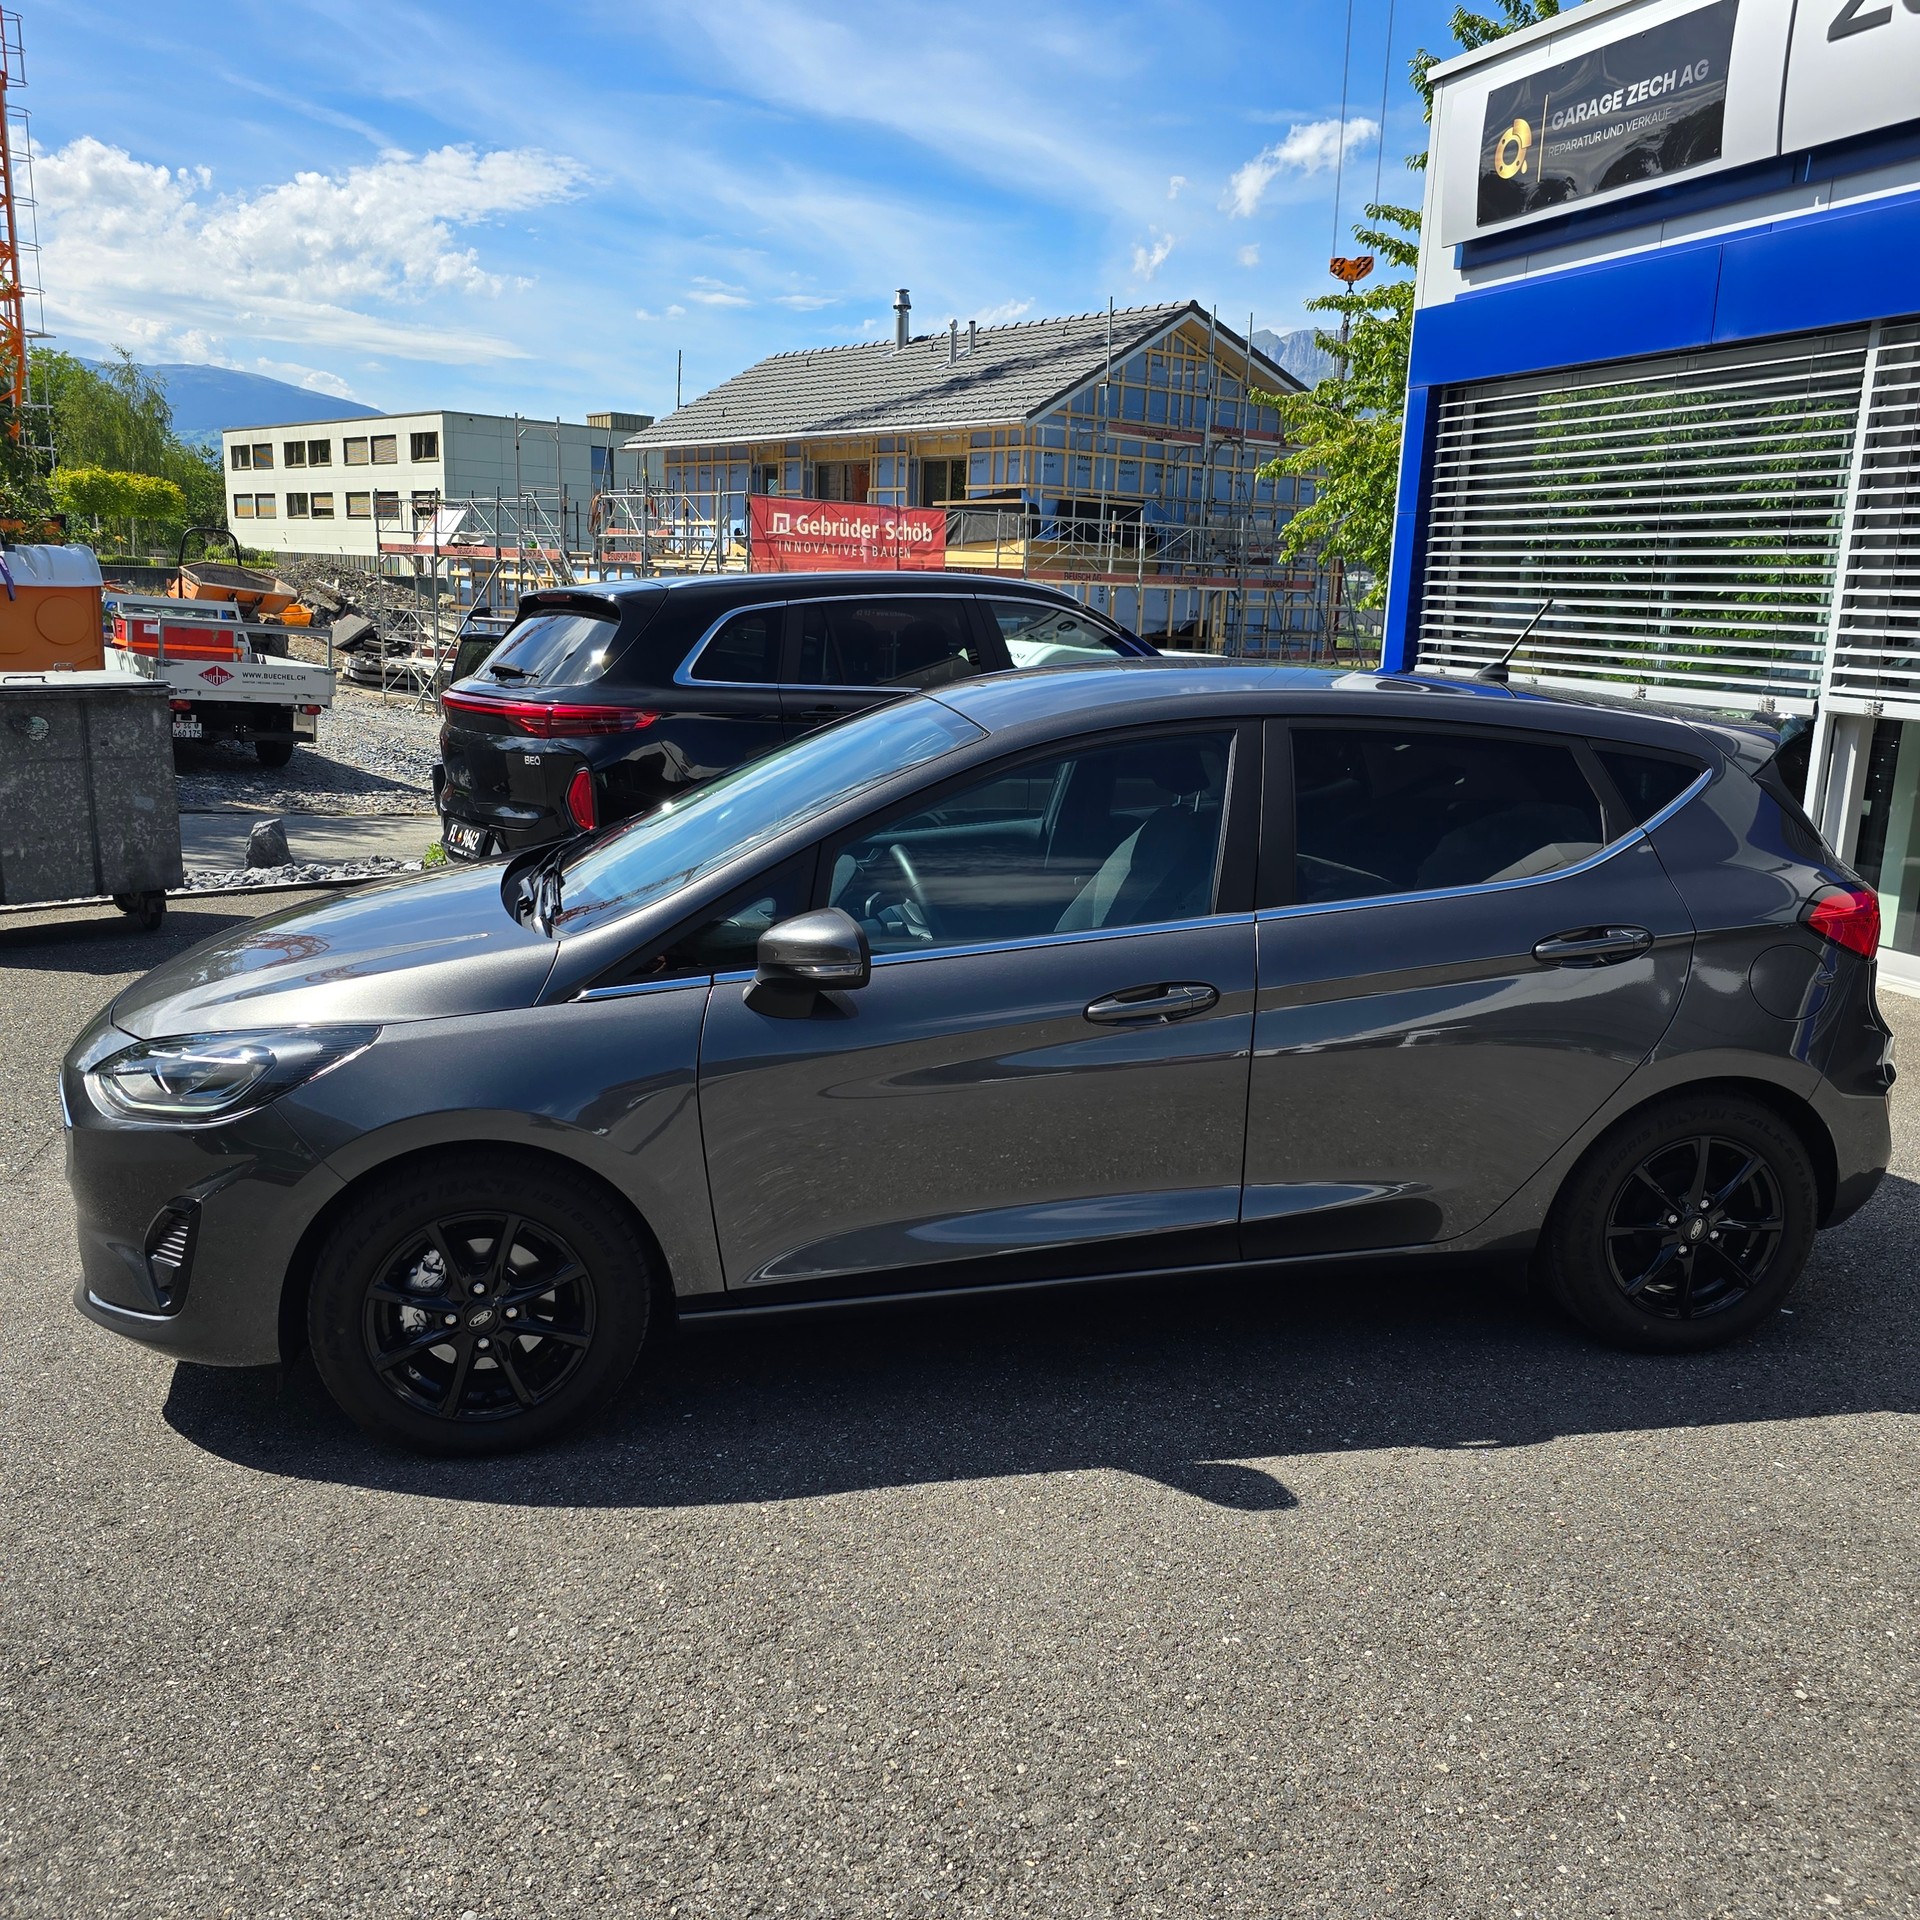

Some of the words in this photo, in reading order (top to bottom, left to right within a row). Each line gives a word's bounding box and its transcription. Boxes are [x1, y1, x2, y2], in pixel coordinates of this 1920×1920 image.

[1551, 87, 1625, 131] GARAGE
[1626, 69, 1678, 107] ZECH
[1679, 58, 1710, 89] AG
[1547, 131, 1602, 158] REPARATUR
[1604, 123, 1624, 140] UND
[1625, 107, 1673, 133] VERKAUF
[796, 514, 879, 540] Gebrüder
[885, 520, 933, 543] Schöb
[778, 540, 864, 558] INNOVATIVES
[872, 546, 912, 560] BAUEN
[1064, 571, 1090, 582] BEUSCH
[1092, 573, 1102, 582] AG
[1262, 580, 1285, 588] BEUSCH
[242, 671, 307, 682] WWW.BUECHEL.CH
[173, 729, 187, 738] 460
[188, 730, 202, 738] 175
[447, 823, 459, 843] FL
